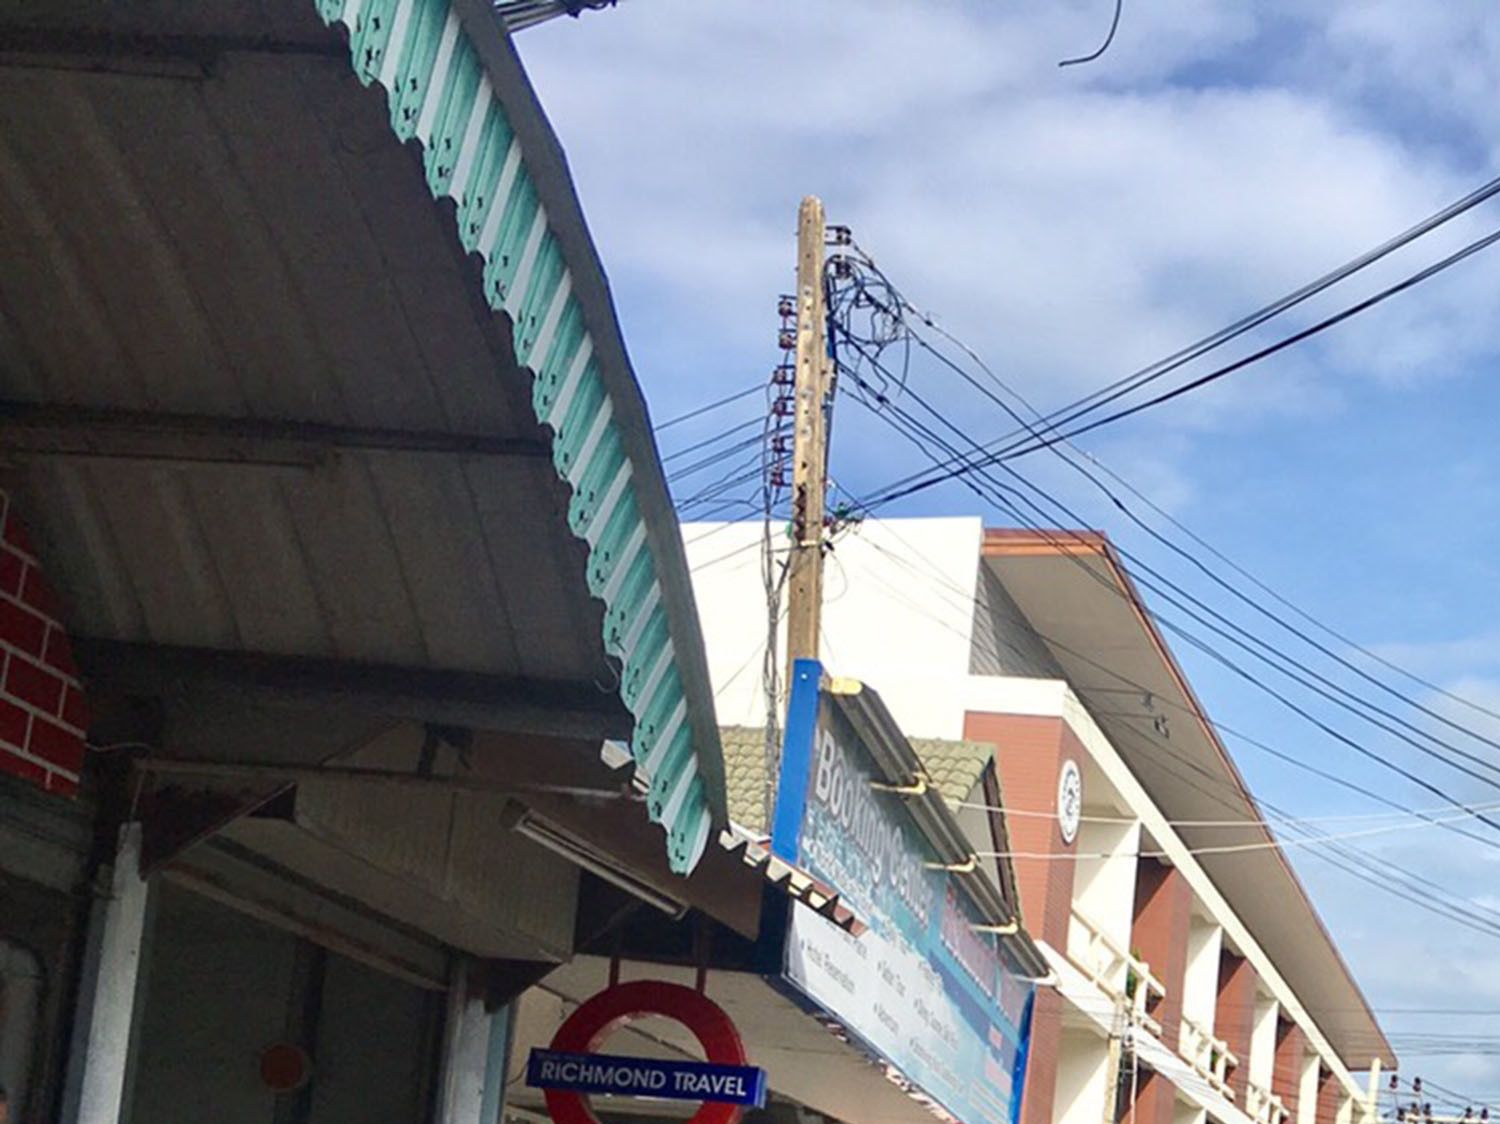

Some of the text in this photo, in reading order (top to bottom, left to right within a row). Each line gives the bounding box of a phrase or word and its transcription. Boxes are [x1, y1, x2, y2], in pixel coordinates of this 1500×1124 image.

[815, 730, 883, 887] Booking
[540, 1061, 747, 1098] RICHMOND TRAVEL
